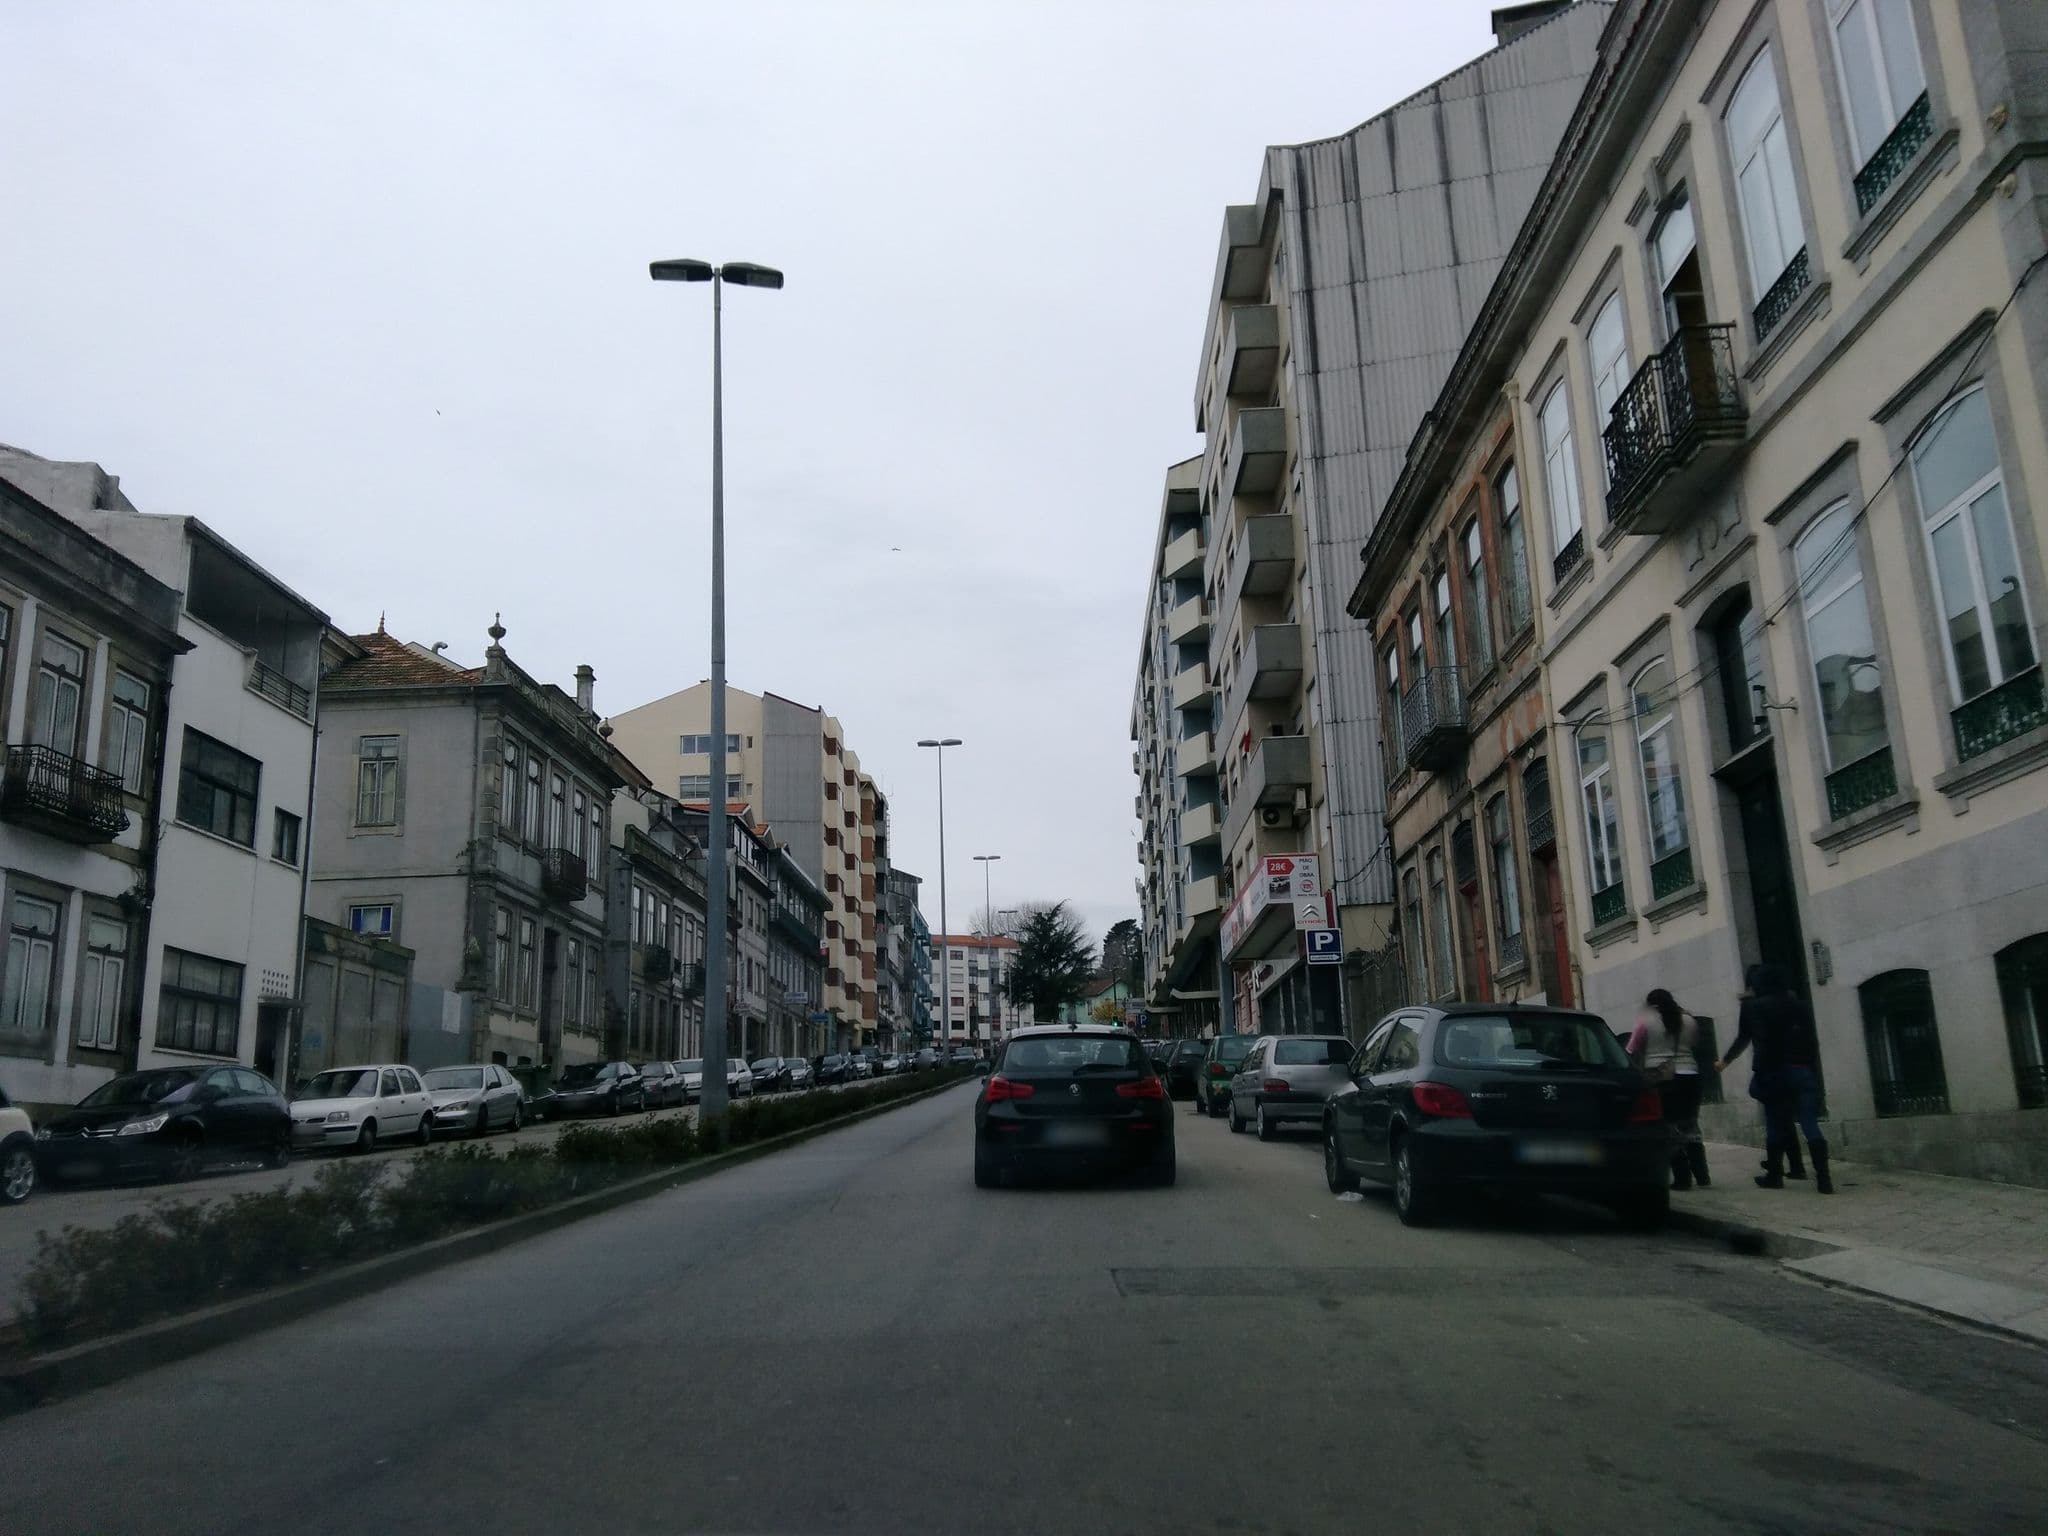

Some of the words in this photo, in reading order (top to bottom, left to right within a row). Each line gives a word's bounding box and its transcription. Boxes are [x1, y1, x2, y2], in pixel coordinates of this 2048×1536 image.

[1270, 863, 1287, 871] 28€
[1315, 932, 1334, 951] P
[1140, 1014, 1147, 1025] P
